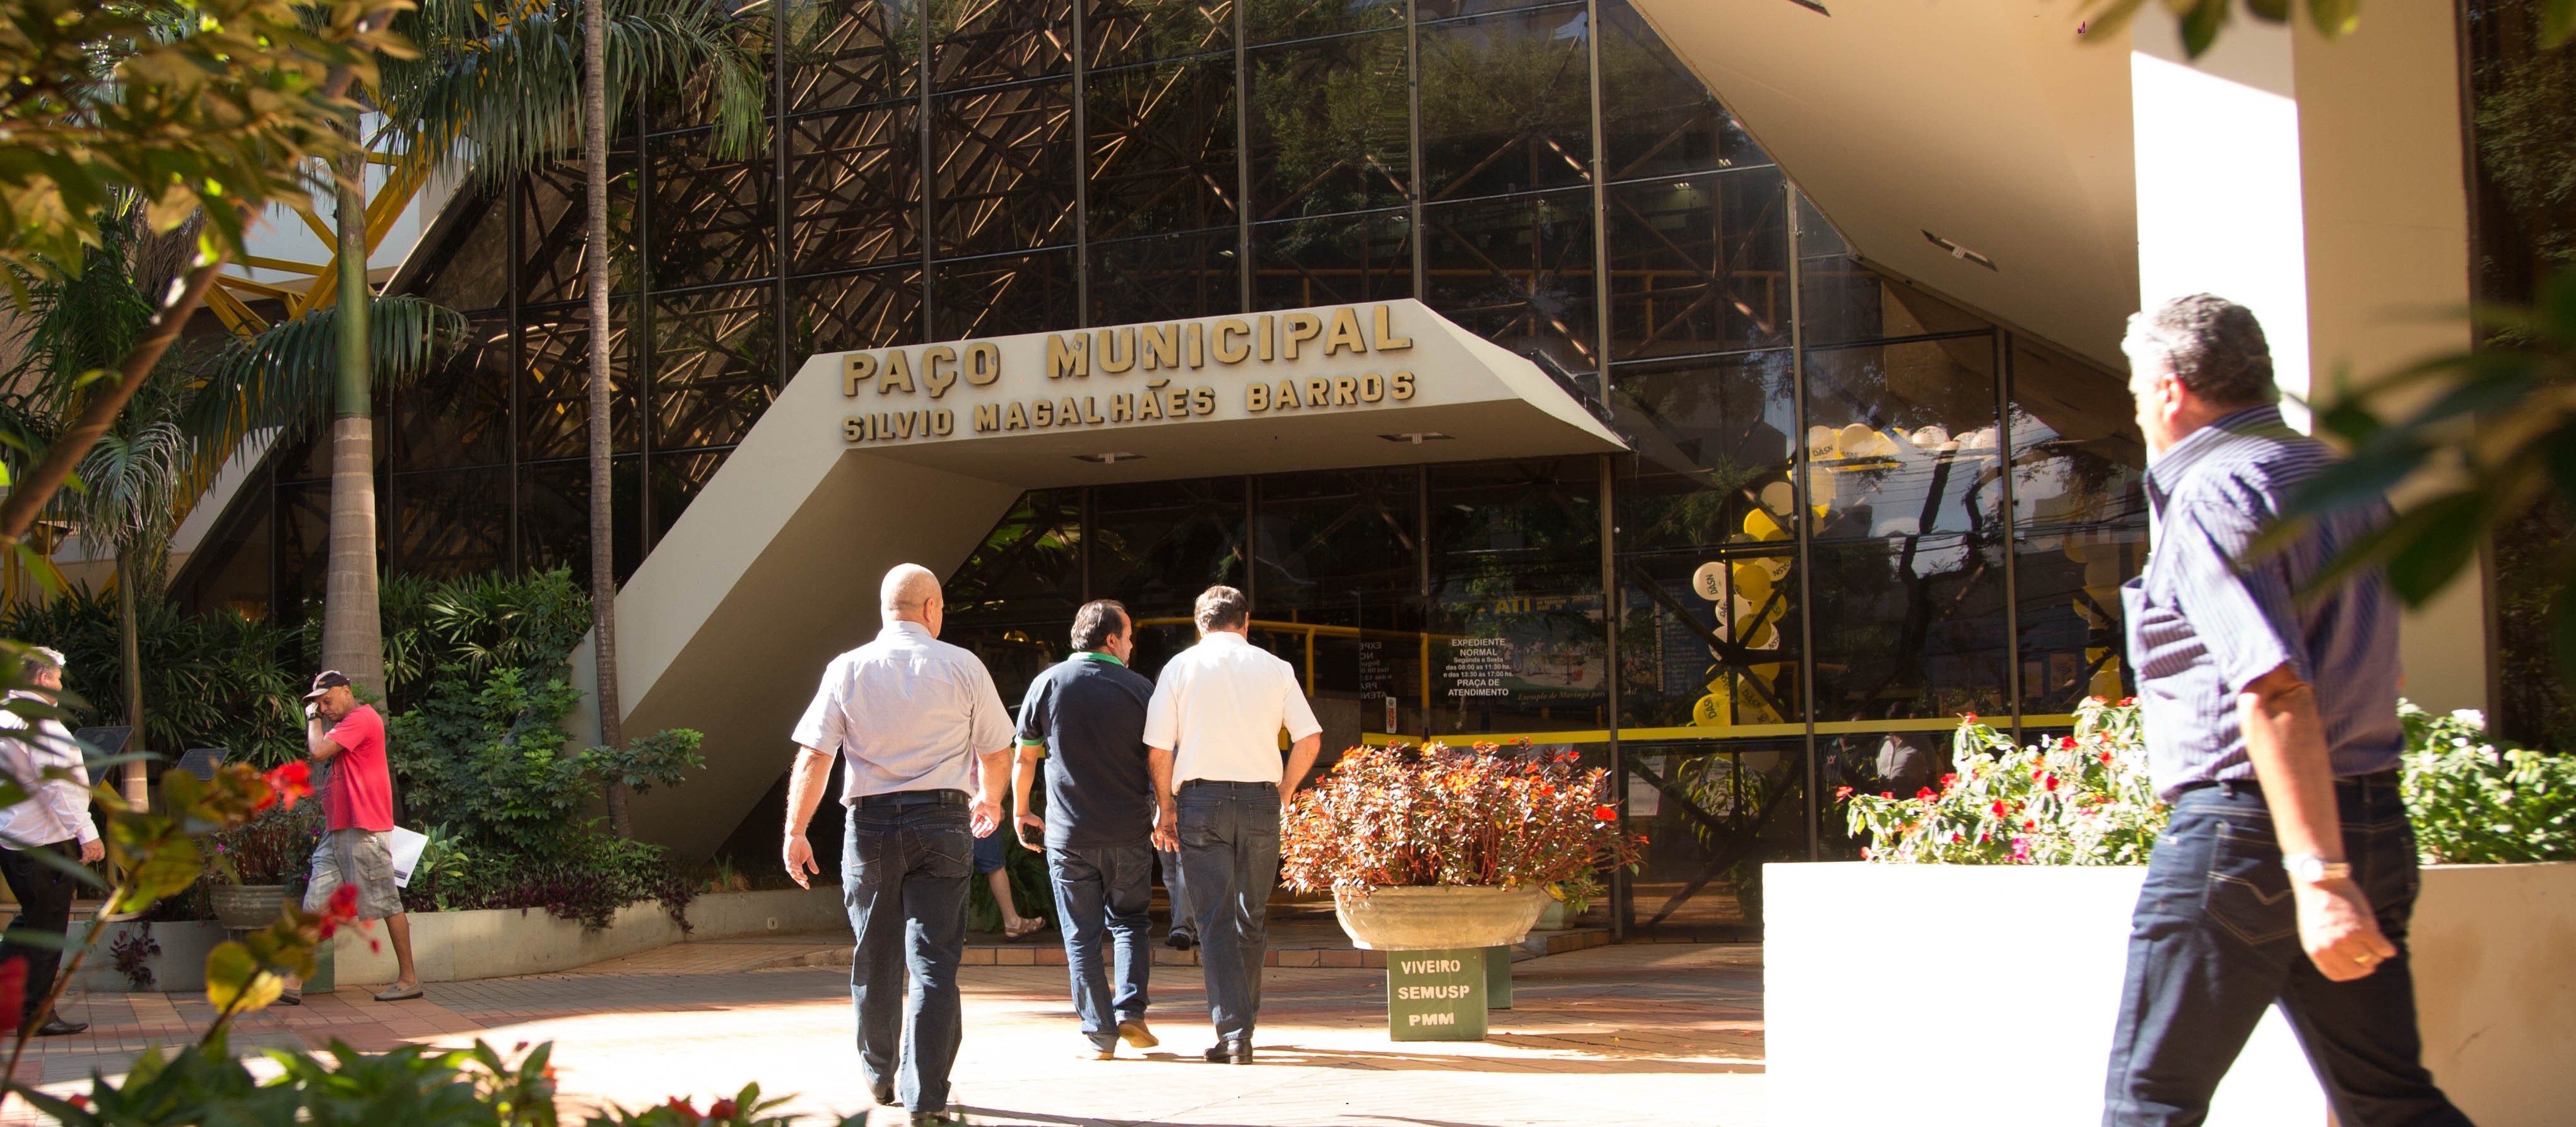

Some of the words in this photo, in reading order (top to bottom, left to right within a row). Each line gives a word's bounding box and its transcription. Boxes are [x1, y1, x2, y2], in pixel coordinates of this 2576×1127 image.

[842, 341, 1001, 398] PAÇO
[1047, 305, 1413, 379] MUNICIPAL
[842, 408, 954, 442] SILVIO
[974, 379, 1216, 432] MAGALHÃES
[1246, 370, 1416, 413] BARROS
[1452, 638, 1506, 647] EXPEDIENTE
[1460, 648, 1498, 656] NORMAL
[1457, 679, 1486, 688] PRAÇA
[1448, 688, 1509, 696] ATENDIMENTO
[1401, 959, 1461, 975] VIVEIRO
[1397, 985, 1470, 1000] SEMUSP
[1408, 1012, 1455, 1027] PMM
